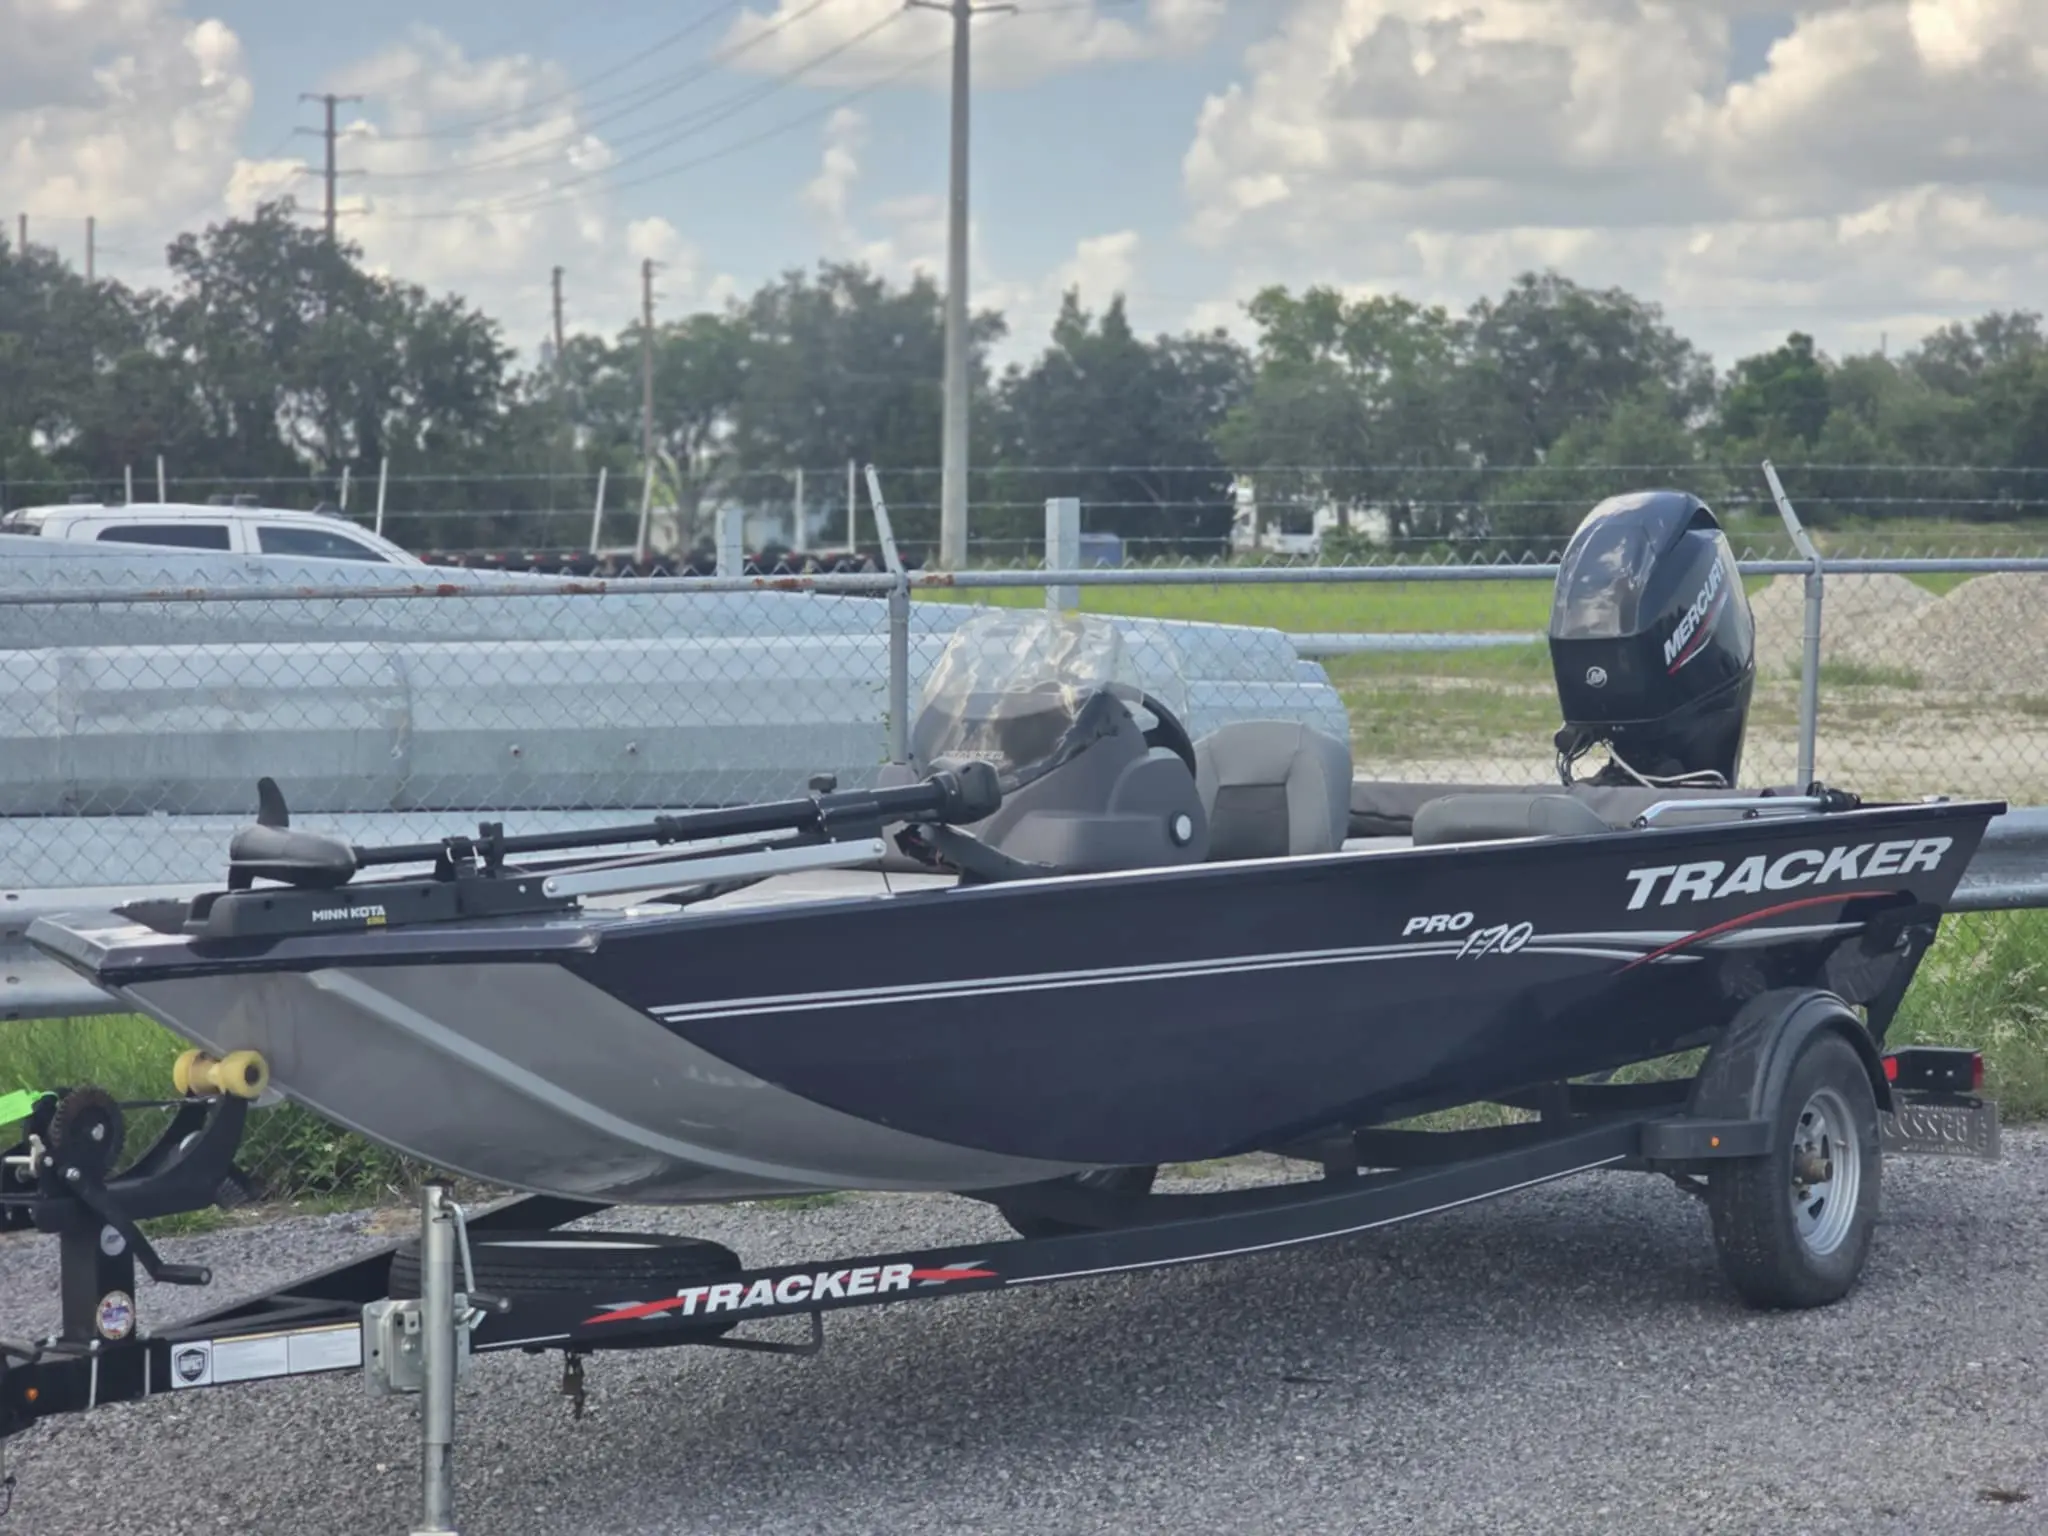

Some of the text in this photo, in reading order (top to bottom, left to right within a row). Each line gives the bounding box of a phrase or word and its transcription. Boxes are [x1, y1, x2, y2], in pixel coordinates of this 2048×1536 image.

[1664, 557, 1724, 665] MERCURY
[1626, 836, 1953, 911] TRACKER
[312, 904, 386, 922] MINN KOTA
[1402, 911, 1533, 960] PRO 170
[676, 1263, 914, 1315] TRACKER
